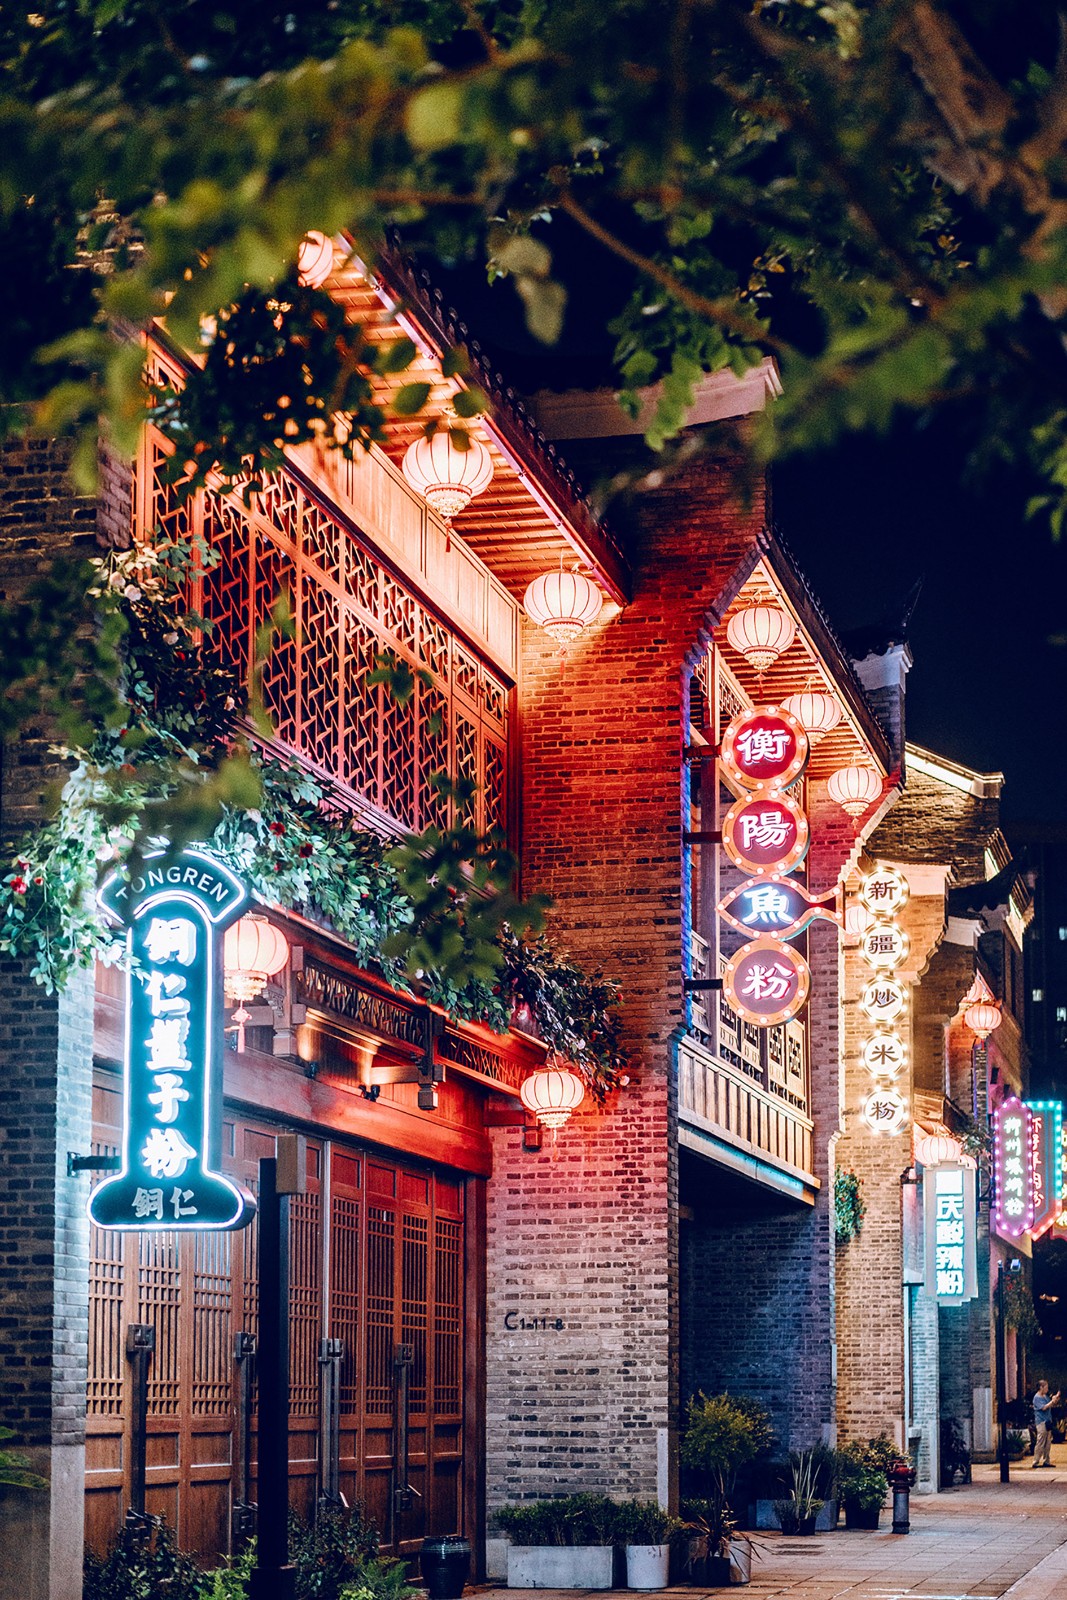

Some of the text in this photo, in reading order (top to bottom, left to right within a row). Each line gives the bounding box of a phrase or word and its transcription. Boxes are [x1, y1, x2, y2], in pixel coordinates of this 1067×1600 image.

[115, 866, 230, 903] TONGREN
[736, 728, 795, 1001] 衡陽魚粉
[867, 879, 899, 1121] 新疆炒米粉
[131, 1186, 198, 1221] 銅仁
[936, 1169, 964, 1295] 庆酸辣粉
